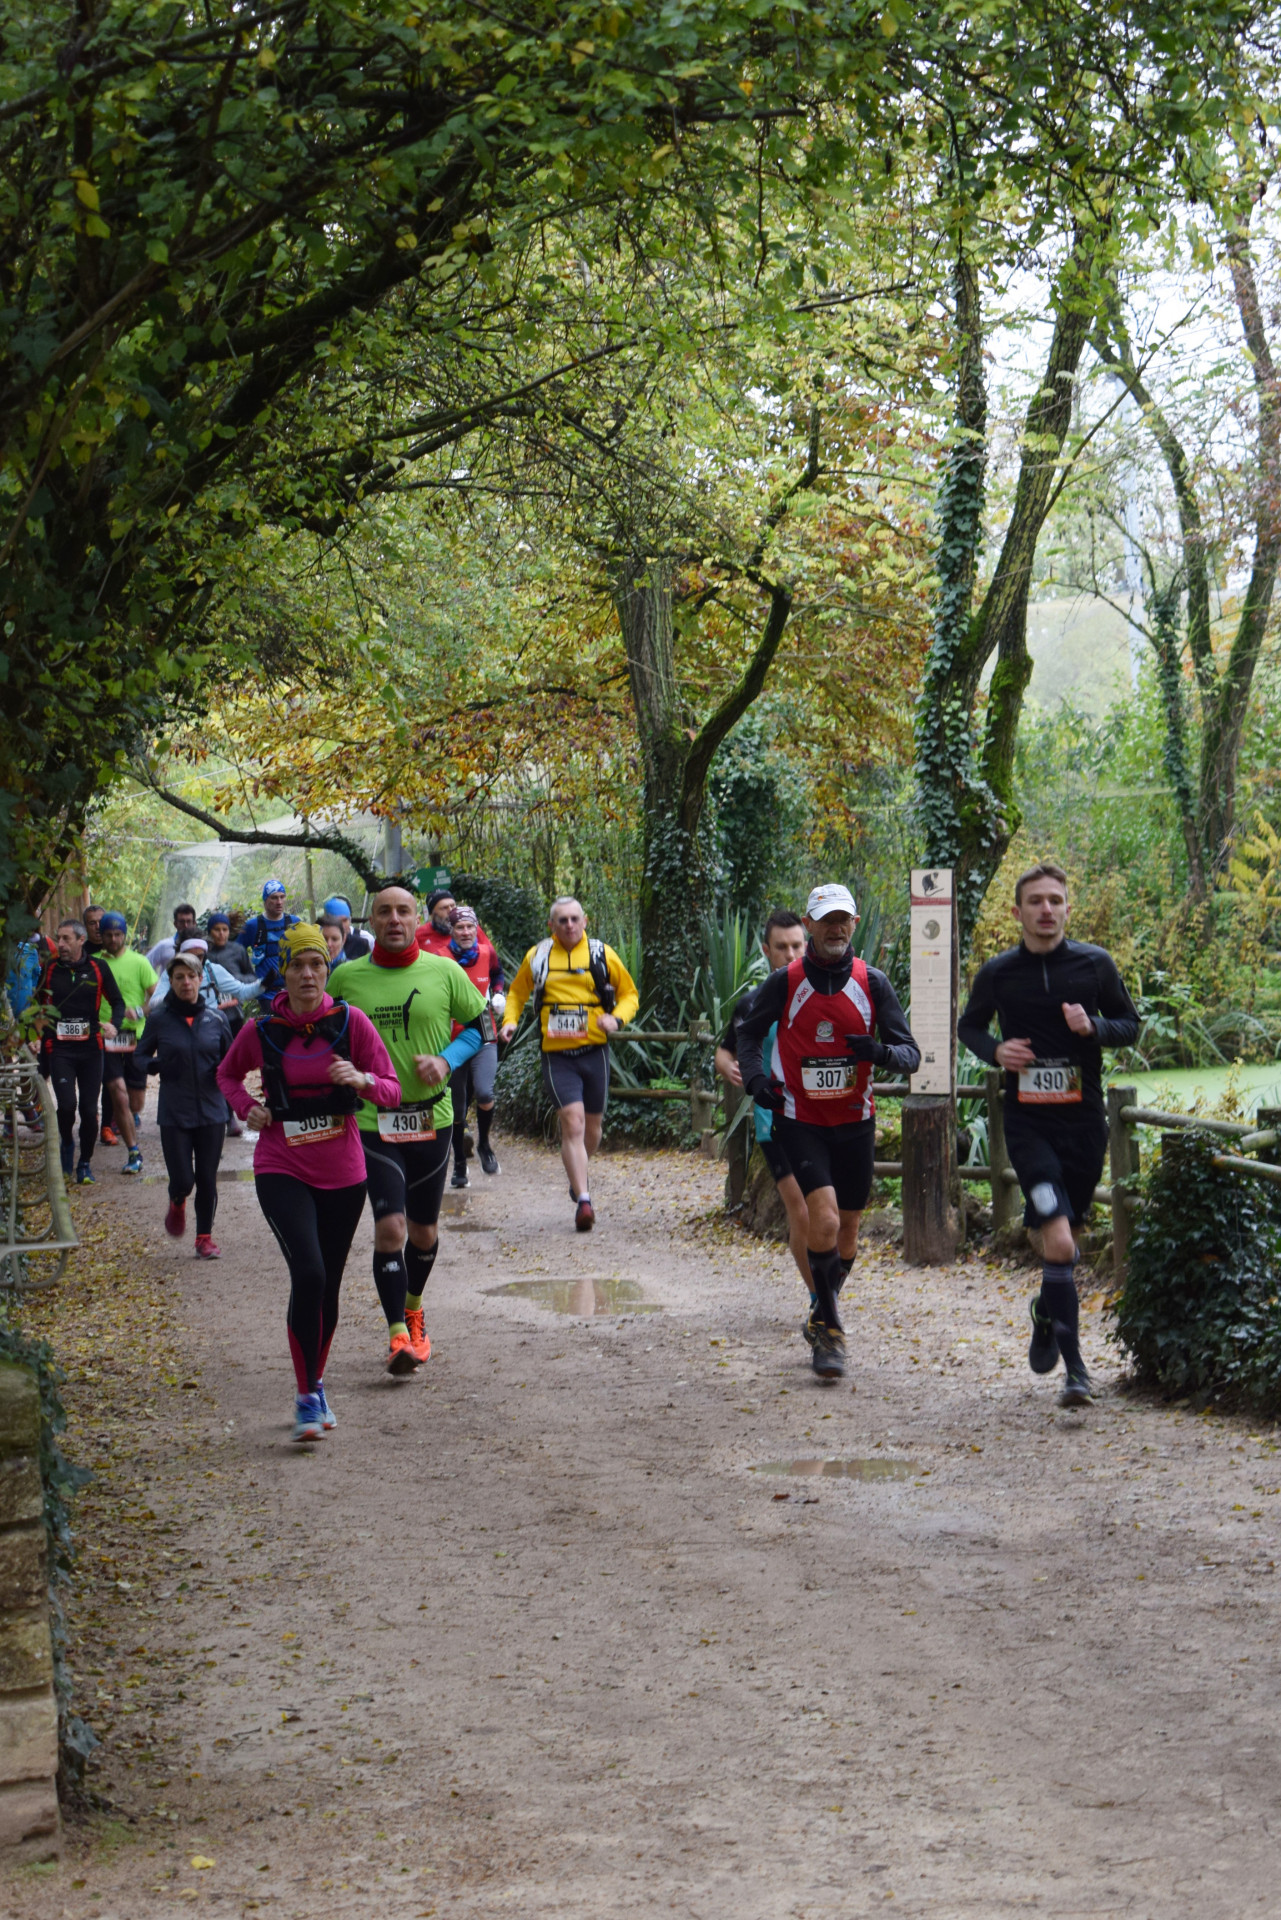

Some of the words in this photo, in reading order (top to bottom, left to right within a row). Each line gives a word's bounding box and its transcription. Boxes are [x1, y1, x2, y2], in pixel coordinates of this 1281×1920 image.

[367, 1012, 391, 1020] ATURE
[392, 1011, 402, 1019] DU
[65, 1024, 80, 1035] 386
[557, 1018, 575, 1029] 544
[816, 1070, 842, 1088] 307
[1033, 1071, 1063, 1090] 490
[392, 1114, 418, 1131] 430
